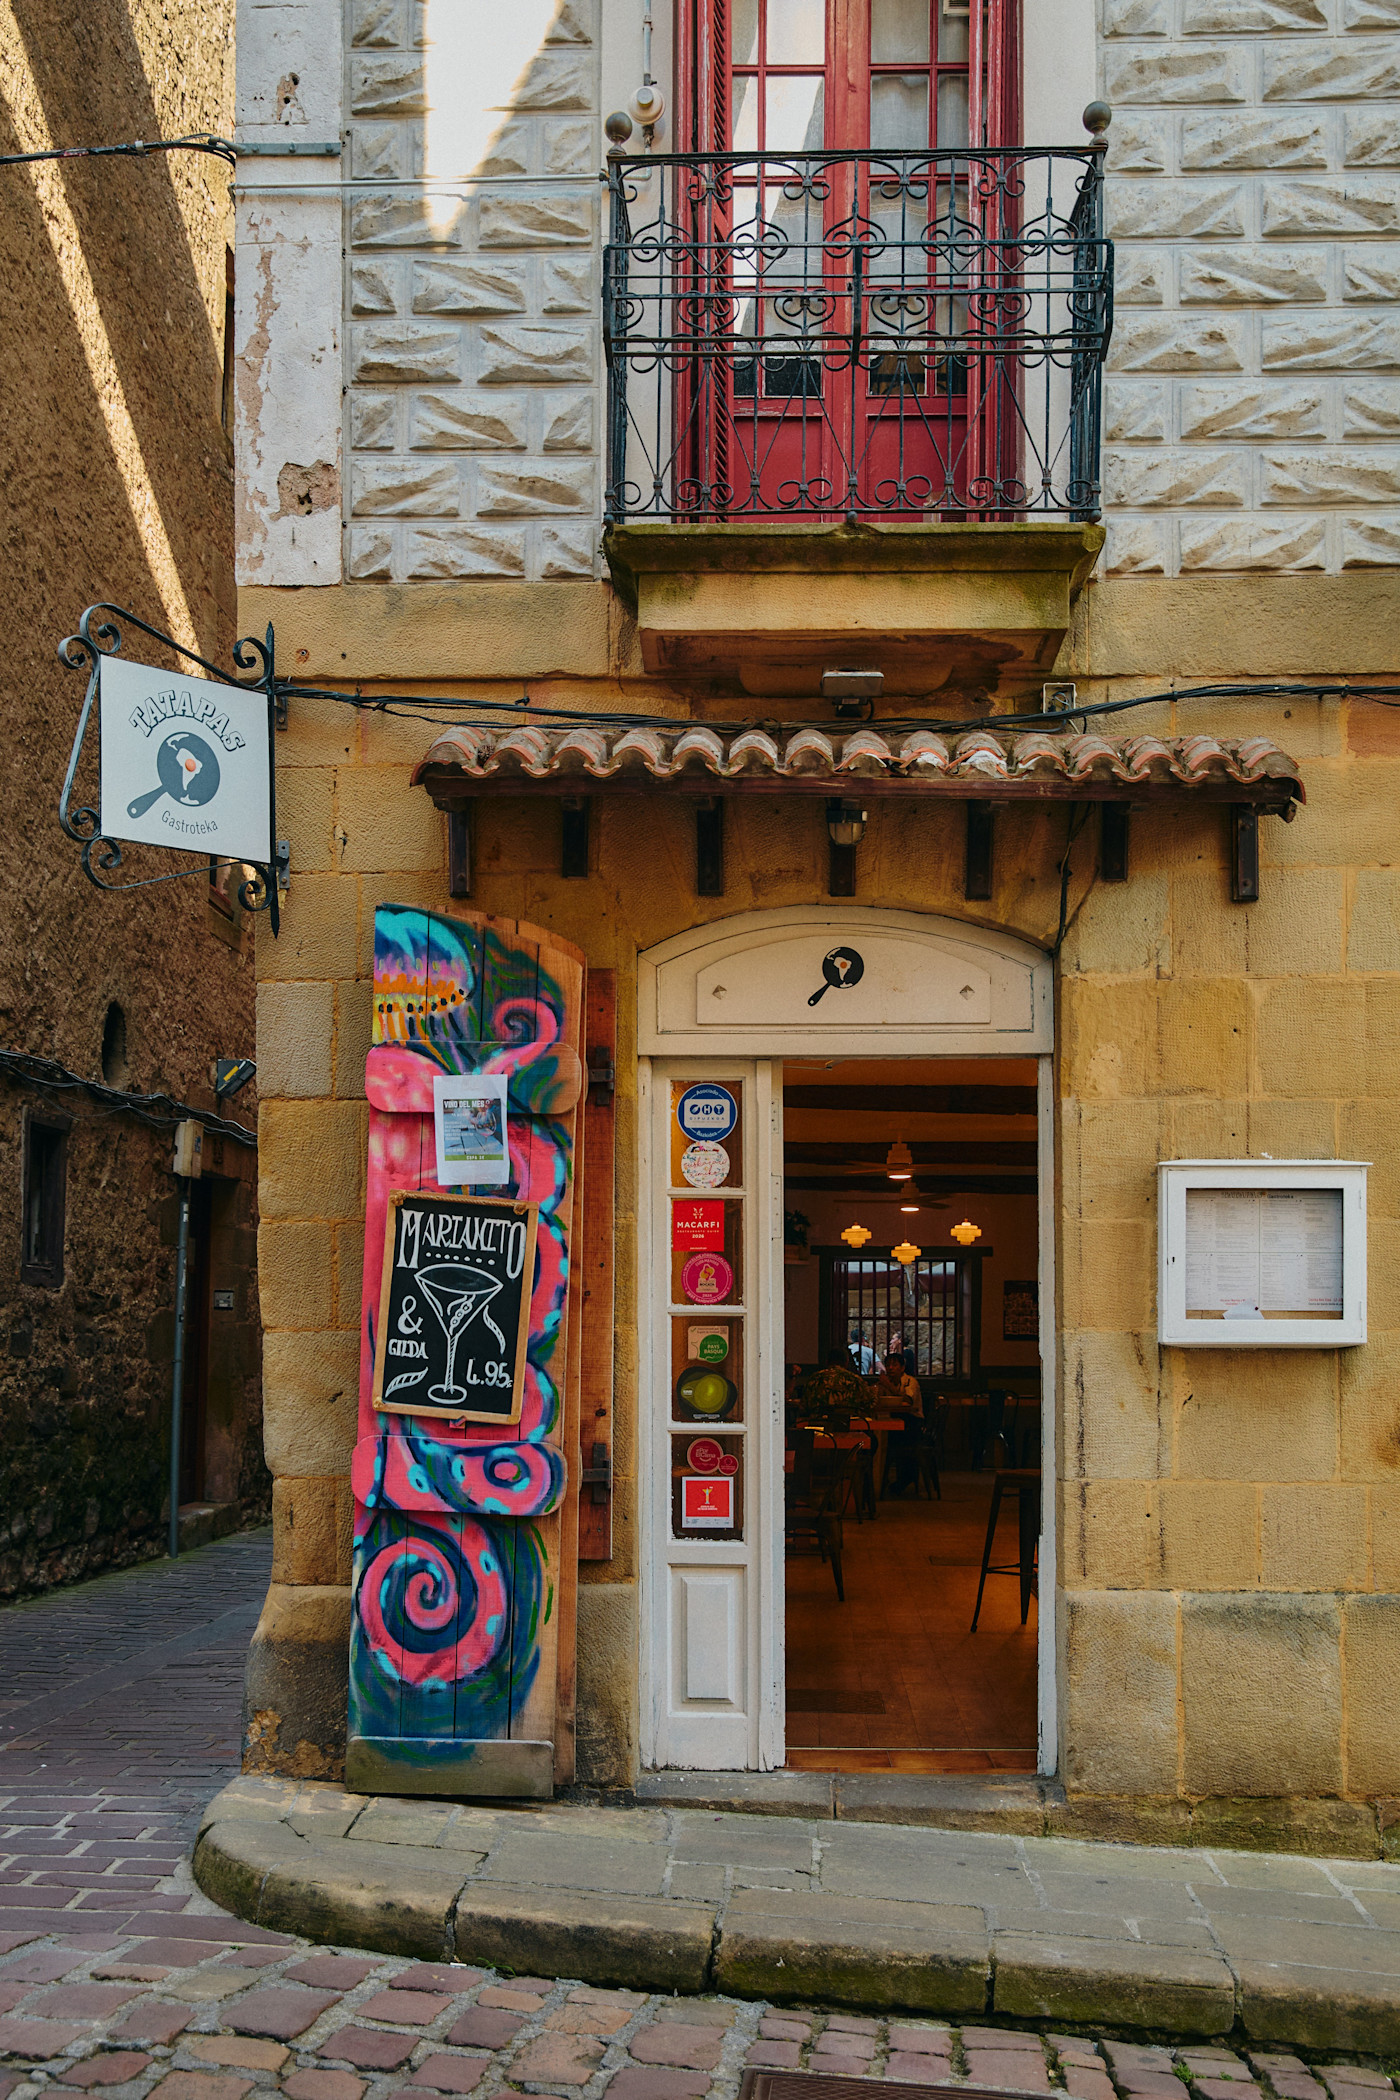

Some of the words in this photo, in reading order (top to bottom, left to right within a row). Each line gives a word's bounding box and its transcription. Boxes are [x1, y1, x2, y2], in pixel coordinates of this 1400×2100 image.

[128, 689, 246, 752] TATAPAS
[161, 809, 218, 835] Gastroteka
[443, 1100, 458, 1109] VINO
[459, 1100, 470, 1108] DEL
[471, 1100, 485, 1108] MES
[677, 1221, 720, 1229] MACARFI
[396, 1208, 527, 1279] MARIANITO
[397, 1295, 423, 1335] &
[388, 1338, 429, 1360] GILDA
